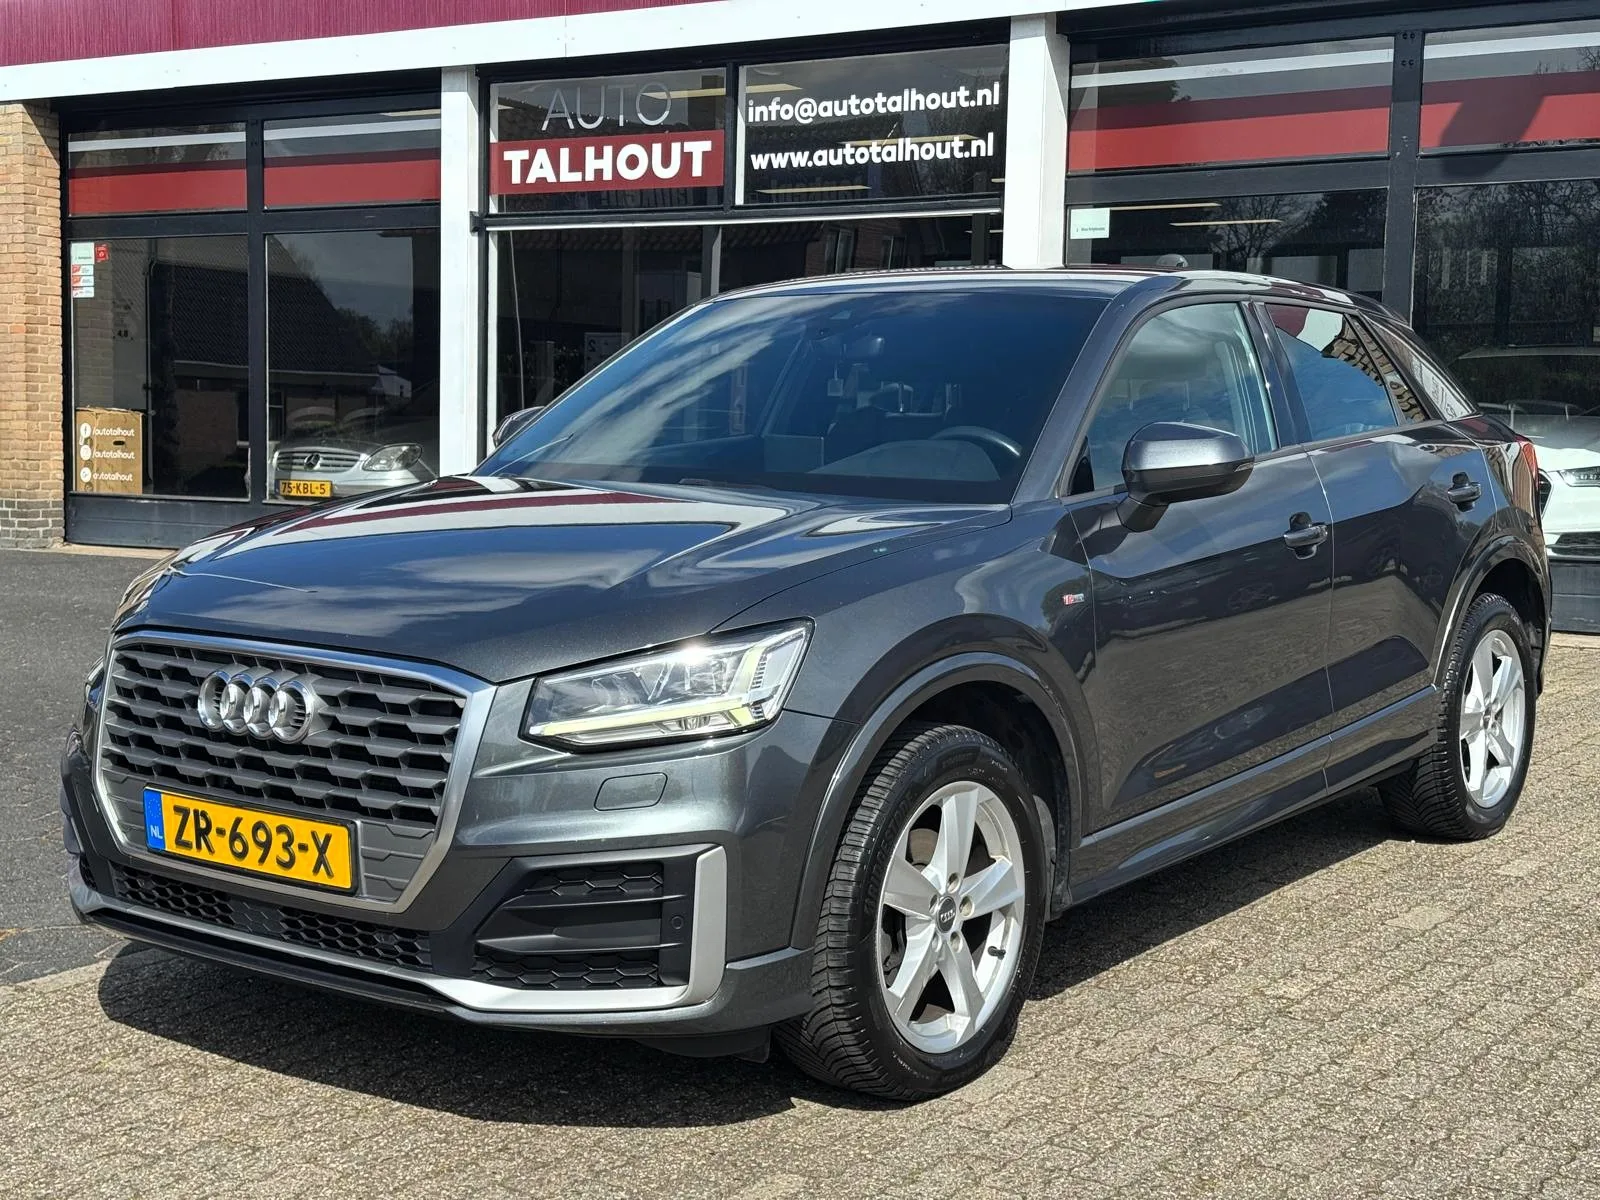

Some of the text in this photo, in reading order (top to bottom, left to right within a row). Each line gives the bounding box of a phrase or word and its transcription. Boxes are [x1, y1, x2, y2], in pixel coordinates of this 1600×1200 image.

[541, 82, 673, 131] AUTO
[748, 81, 1001, 125] info@autotalhout.nl
[503, 140, 712, 185] TALHOUT
[750, 132, 995, 171] www.autotalhout.nl
[281, 482, 326, 495] 75-KBL-5
[150, 826, 163, 840] NL
[173, 805, 334, 879] ZR-693-X
